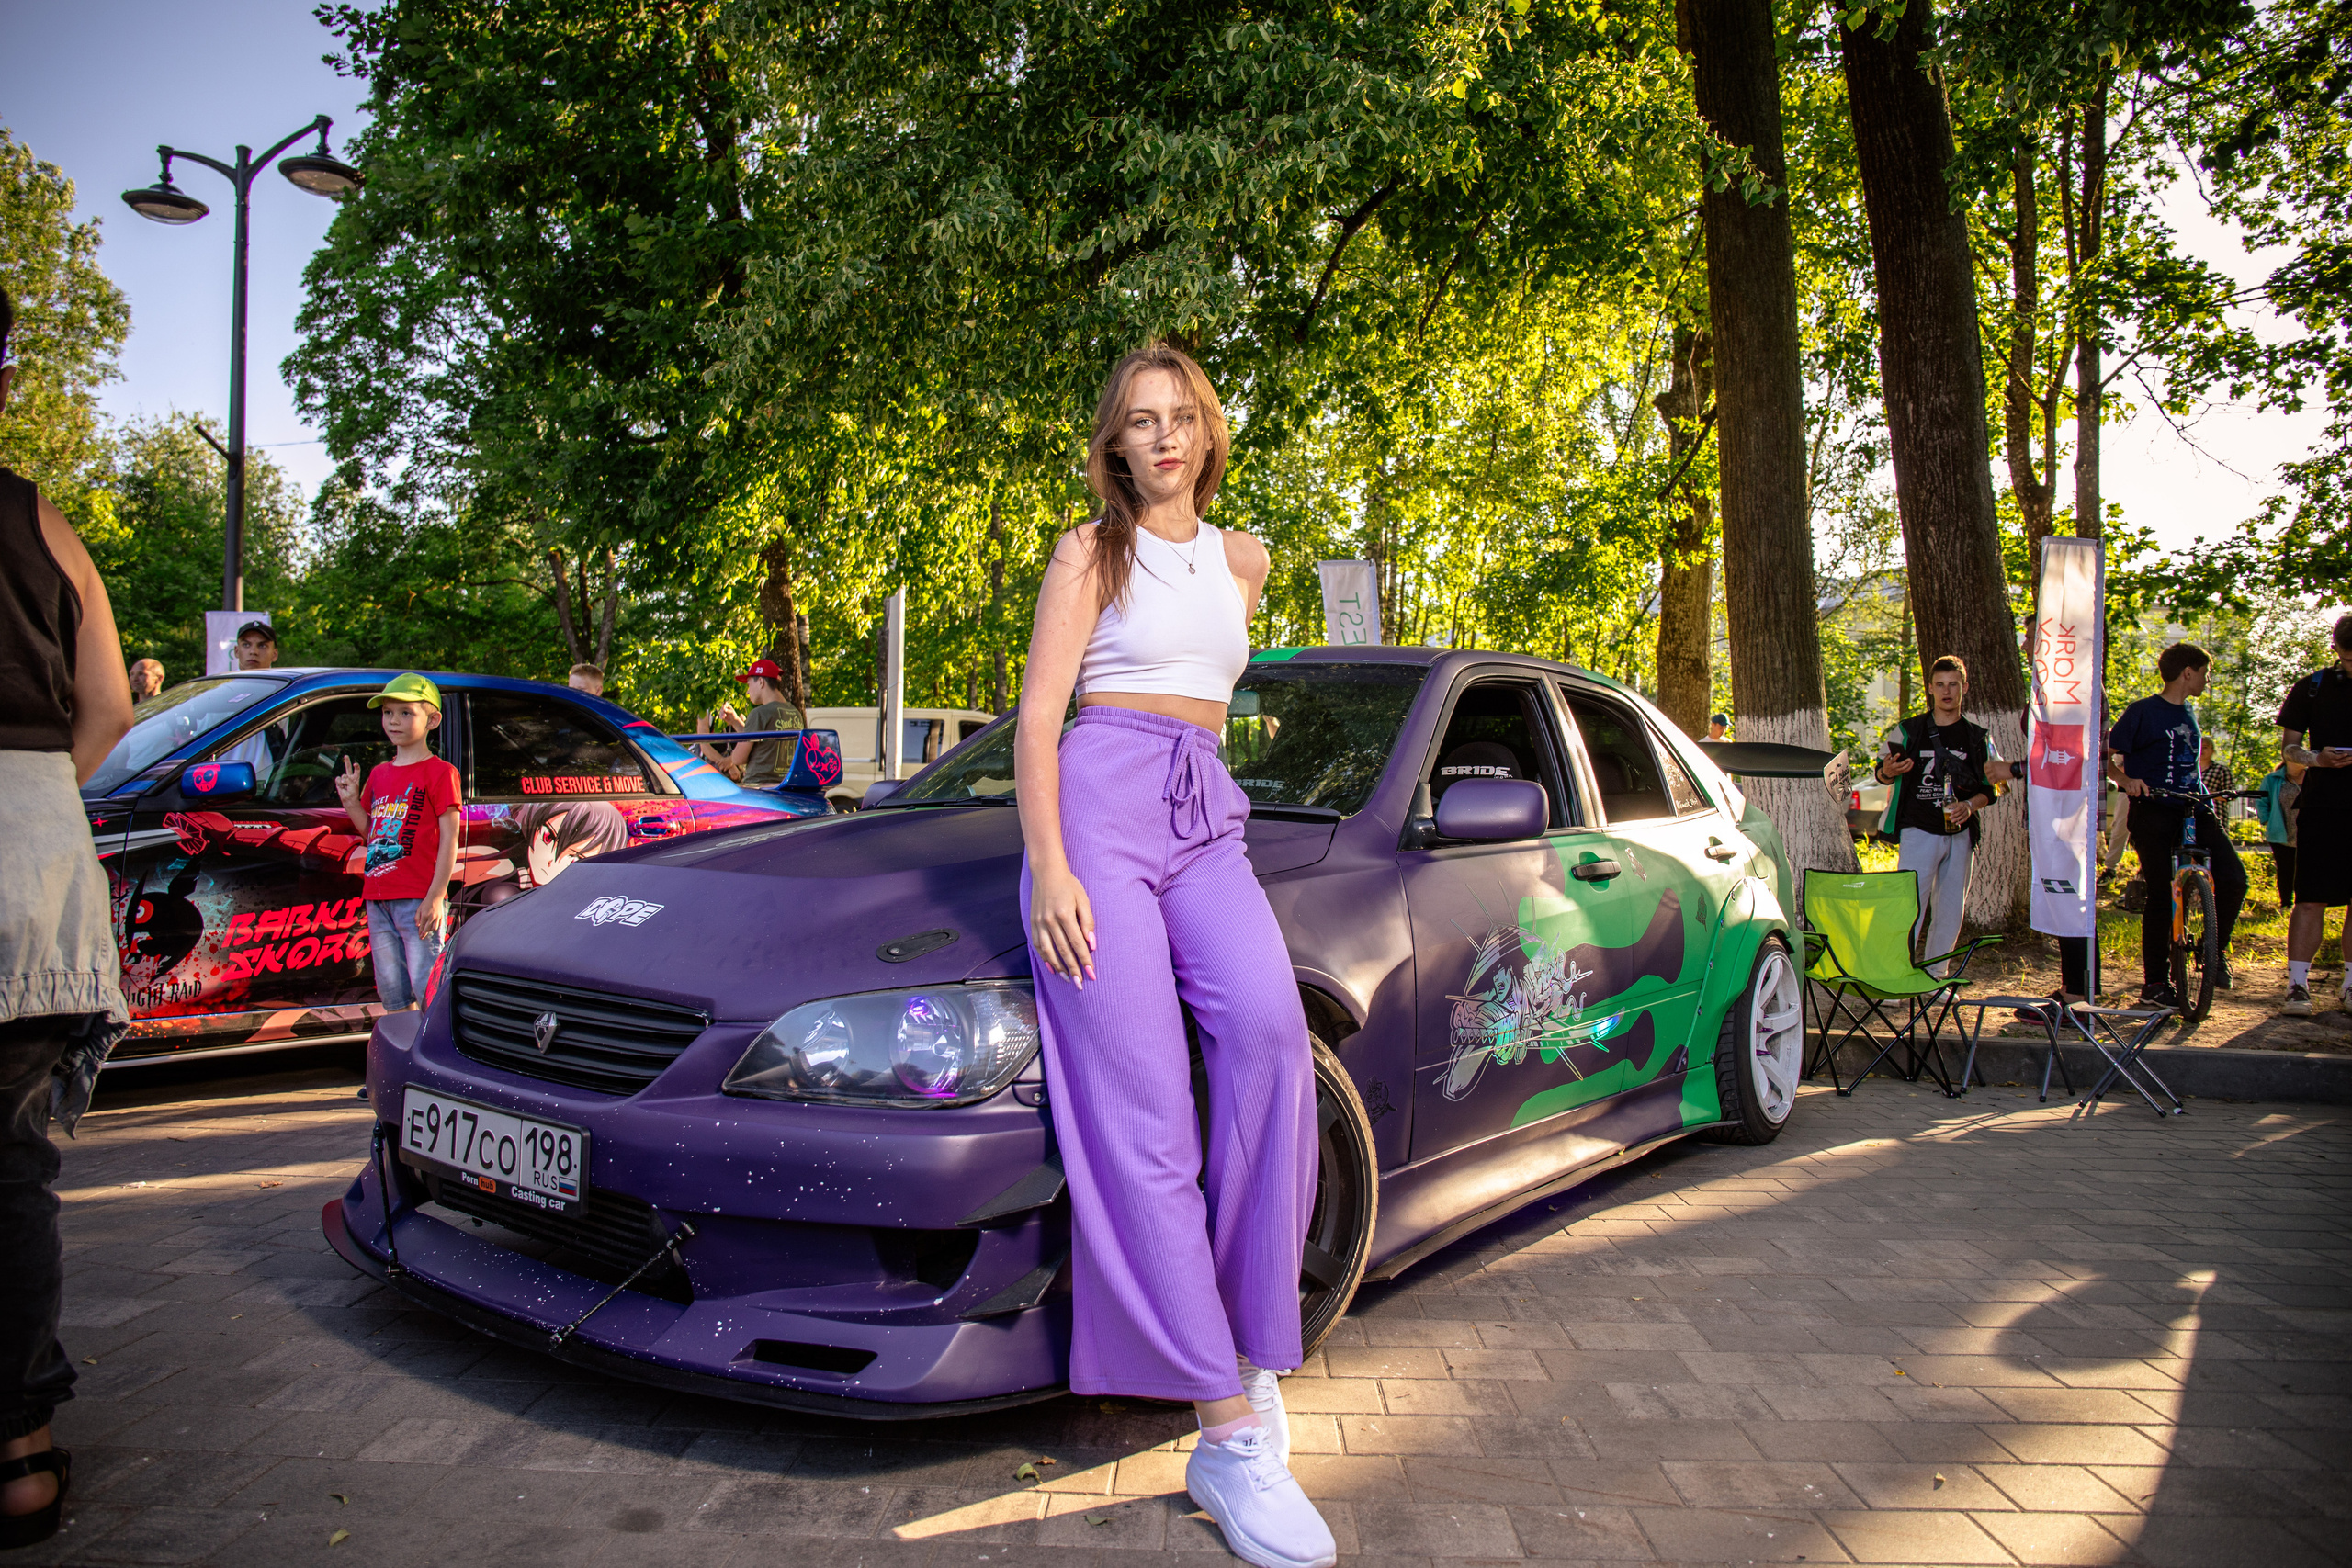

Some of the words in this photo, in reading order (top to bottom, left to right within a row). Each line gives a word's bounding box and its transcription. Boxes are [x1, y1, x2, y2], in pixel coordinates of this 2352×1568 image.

[1441, 765, 1510, 777] BRIDE
[521, 776, 553, 795] CLUB
[553, 776, 603, 794] SERVICE
[603, 776, 613, 793] &
[612, 775, 645, 793] MOVE
[411, 786, 426, 812] RIDE
[405, 813, 421, 826] TO
[525, 1126, 573, 1175] 198
[461, 1171, 479, 1186] Porn
[481, 1179, 494, 1190] hub
[534, 1170, 558, 1190] RUS
[511, 1185, 547, 1209] Casting
[548, 1199, 566, 1211] car
